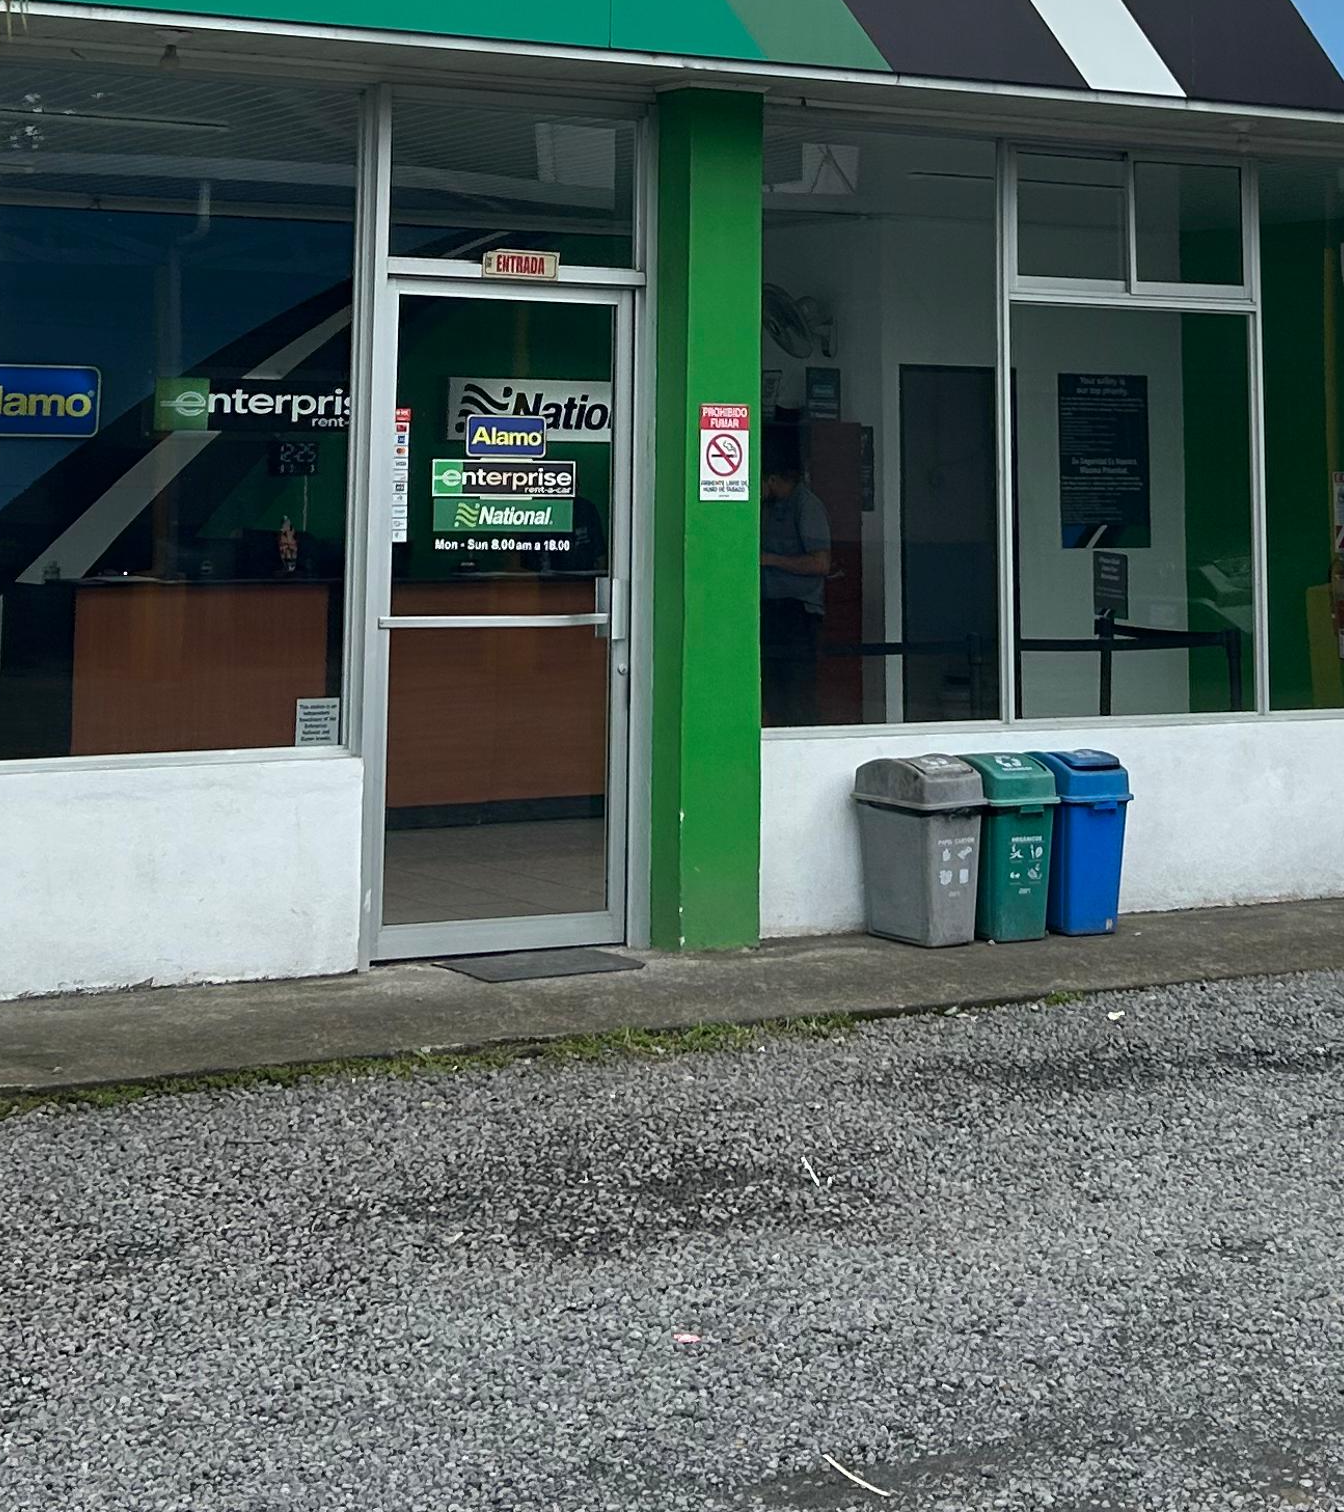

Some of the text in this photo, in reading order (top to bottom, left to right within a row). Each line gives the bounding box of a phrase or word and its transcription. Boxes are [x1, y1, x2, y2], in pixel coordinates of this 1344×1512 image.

[496, 254, 545, 275] ENTRADA
[512, 392, 613, 430] Natio
[702, 407, 748, 418] PROHIBIDO
[710, 418, 739, 429] FUMAR
[472, 426, 543, 446] Alamo
[436, 468, 572, 491] enterprise
[524, 486, 572, 494] rent-a-car
[435, 539, 458, 550] Mon
[467, 539, 488, 550] Sun
[534, 541, 541, 551] a
